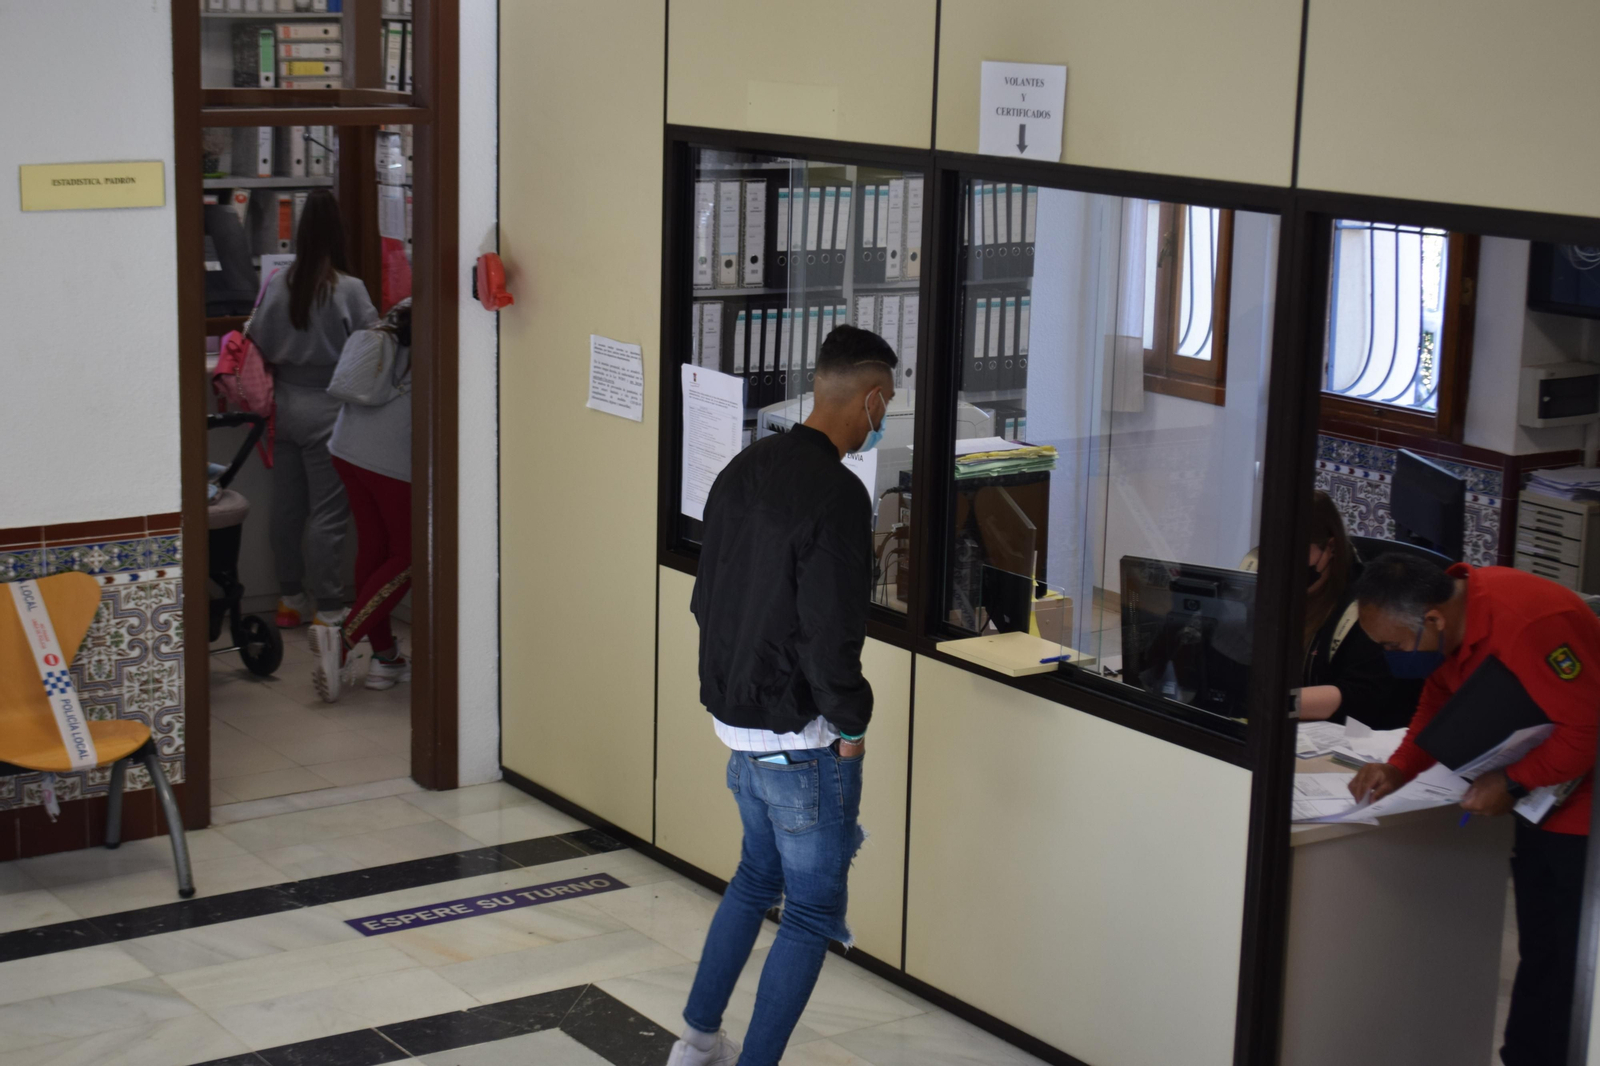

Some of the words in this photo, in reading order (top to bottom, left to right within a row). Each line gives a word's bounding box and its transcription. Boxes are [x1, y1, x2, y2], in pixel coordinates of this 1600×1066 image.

[1004, 77, 1044, 87] VOLANTES
[1021, 93, 1027, 102] Y
[996, 107, 1051, 119] CERTIFICADOS
[19, 585, 38, 611] LOCAL
[72, 732, 89, 760] LOCAL
[362, 904, 474, 931] ESPERE
[476, 895, 516, 910] SU
[516, 878, 612, 901] TURNO
